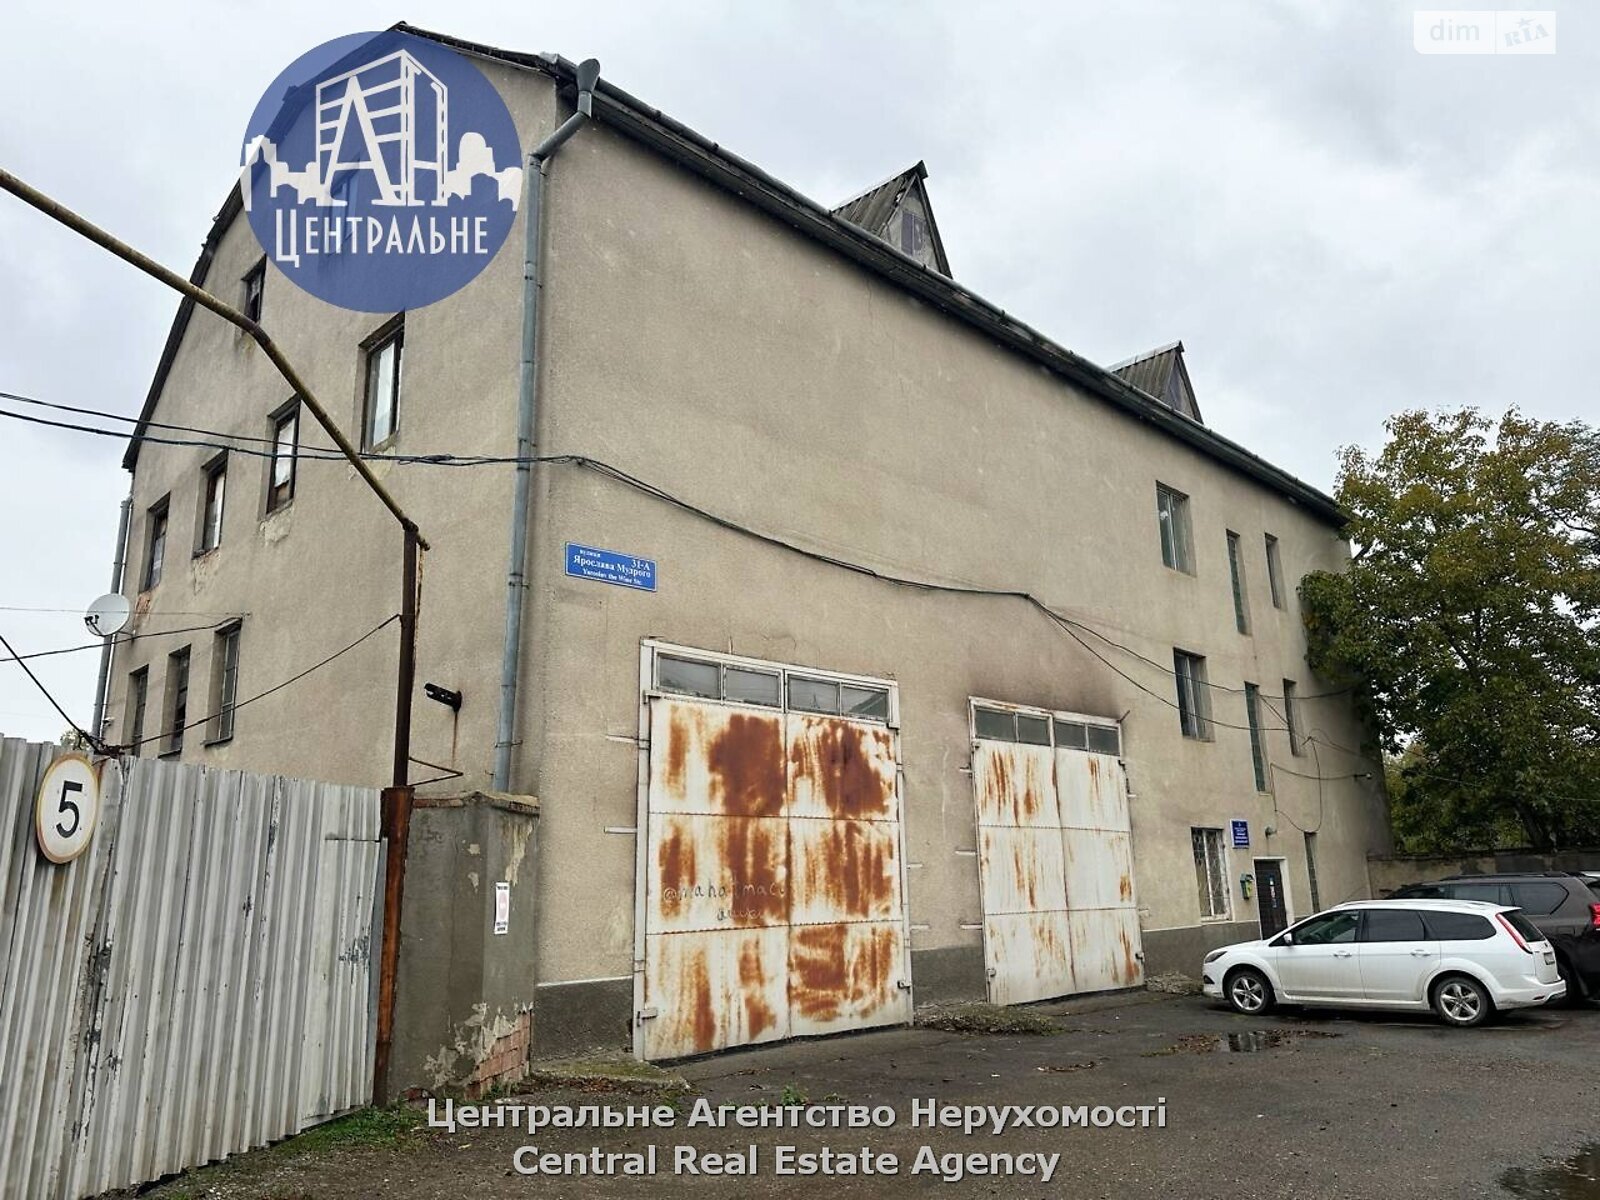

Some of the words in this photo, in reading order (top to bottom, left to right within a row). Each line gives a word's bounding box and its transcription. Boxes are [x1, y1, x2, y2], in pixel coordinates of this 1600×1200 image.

[573, 554, 615, 570] Ярослава
[616, 562, 651, 578] Мудрого
[56, 780, 83, 839] 5
